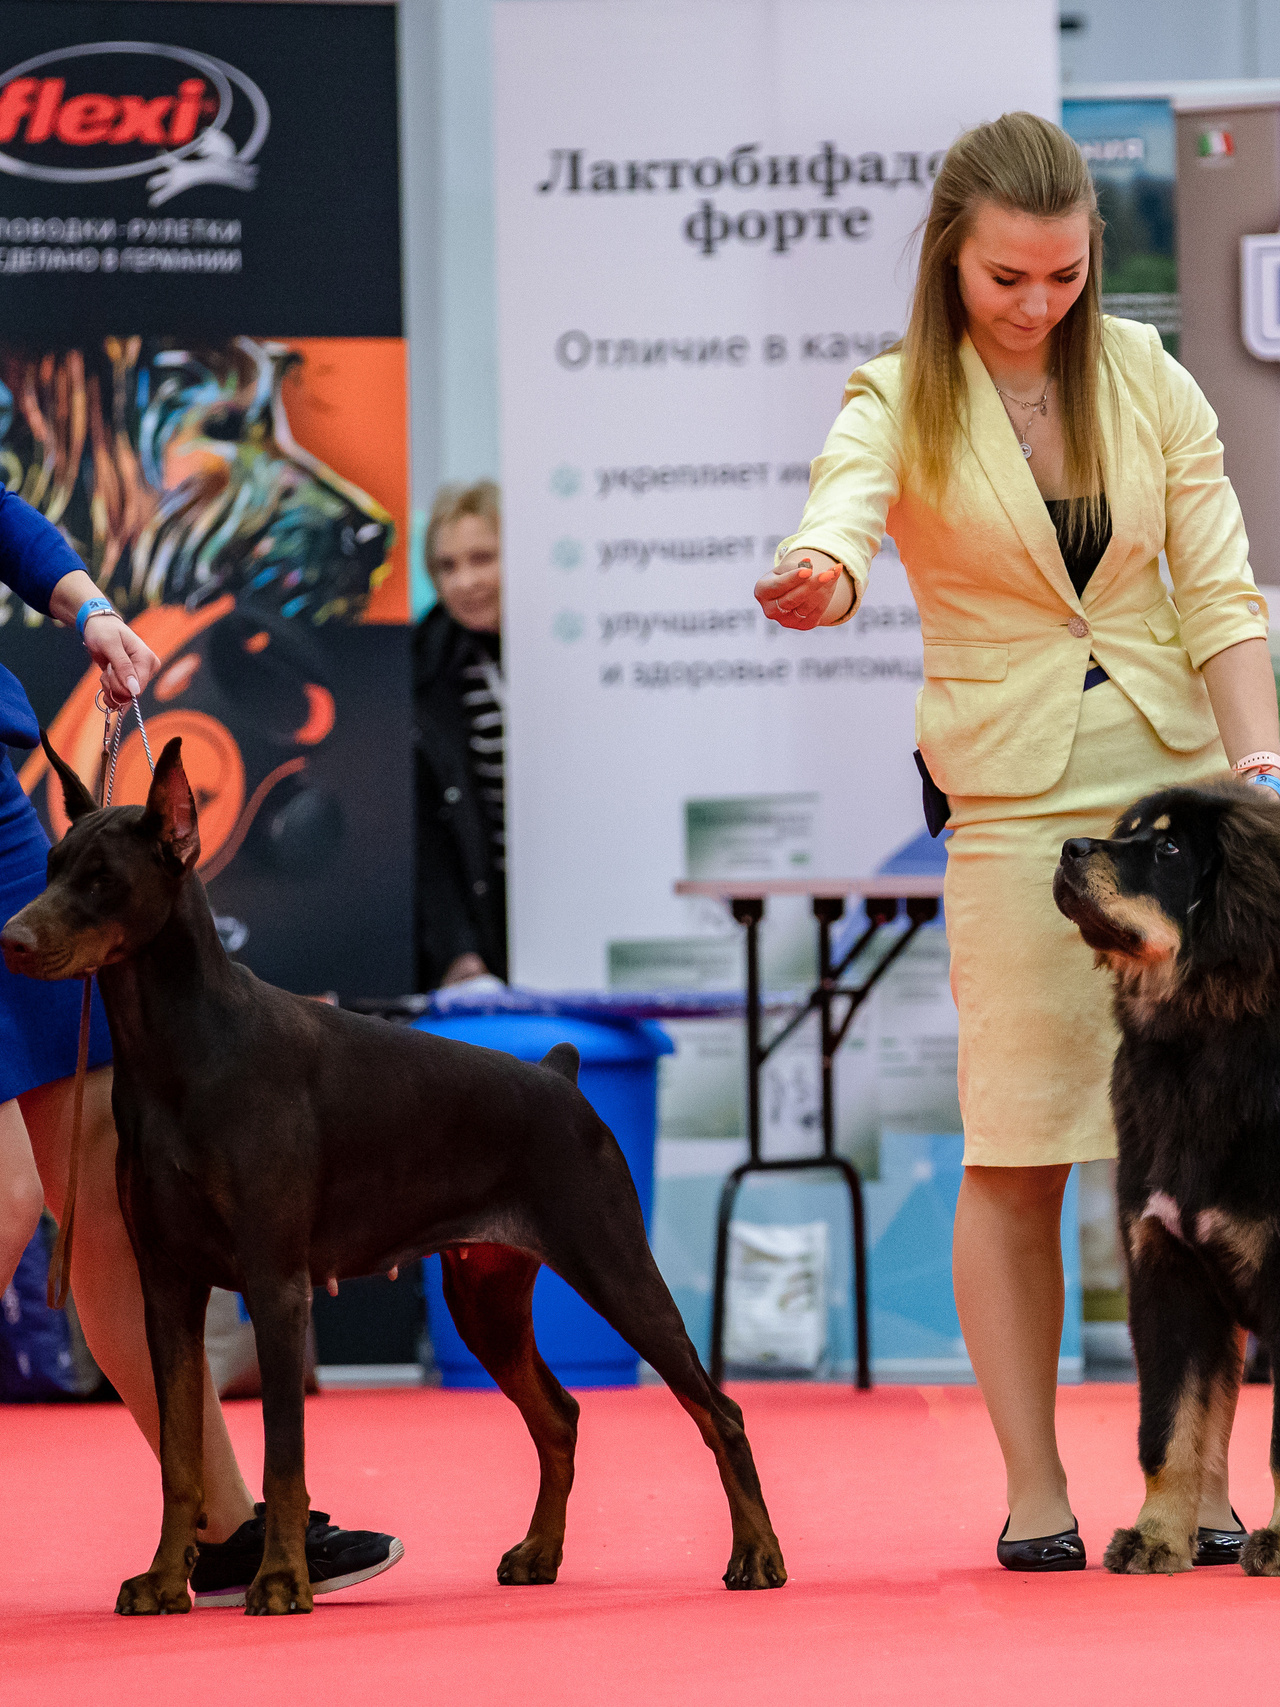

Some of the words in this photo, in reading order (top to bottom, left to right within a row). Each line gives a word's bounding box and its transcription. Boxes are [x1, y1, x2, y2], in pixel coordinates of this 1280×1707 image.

[0, 77, 207, 146] flexi
[127, 217, 242, 243] РУЛЕТКИ
[684, 199, 872, 255] форте
[120, 247, 242, 274] ГЕРМАНИИ
[555, 328, 750, 371] Отличие
[762, 333, 790, 364] в
[597, 463, 768, 496] укрепляет
[599, 536, 755, 569] улучшает
[602, 610, 756, 643] улучшает
[633, 658, 790, 689] здоровье
